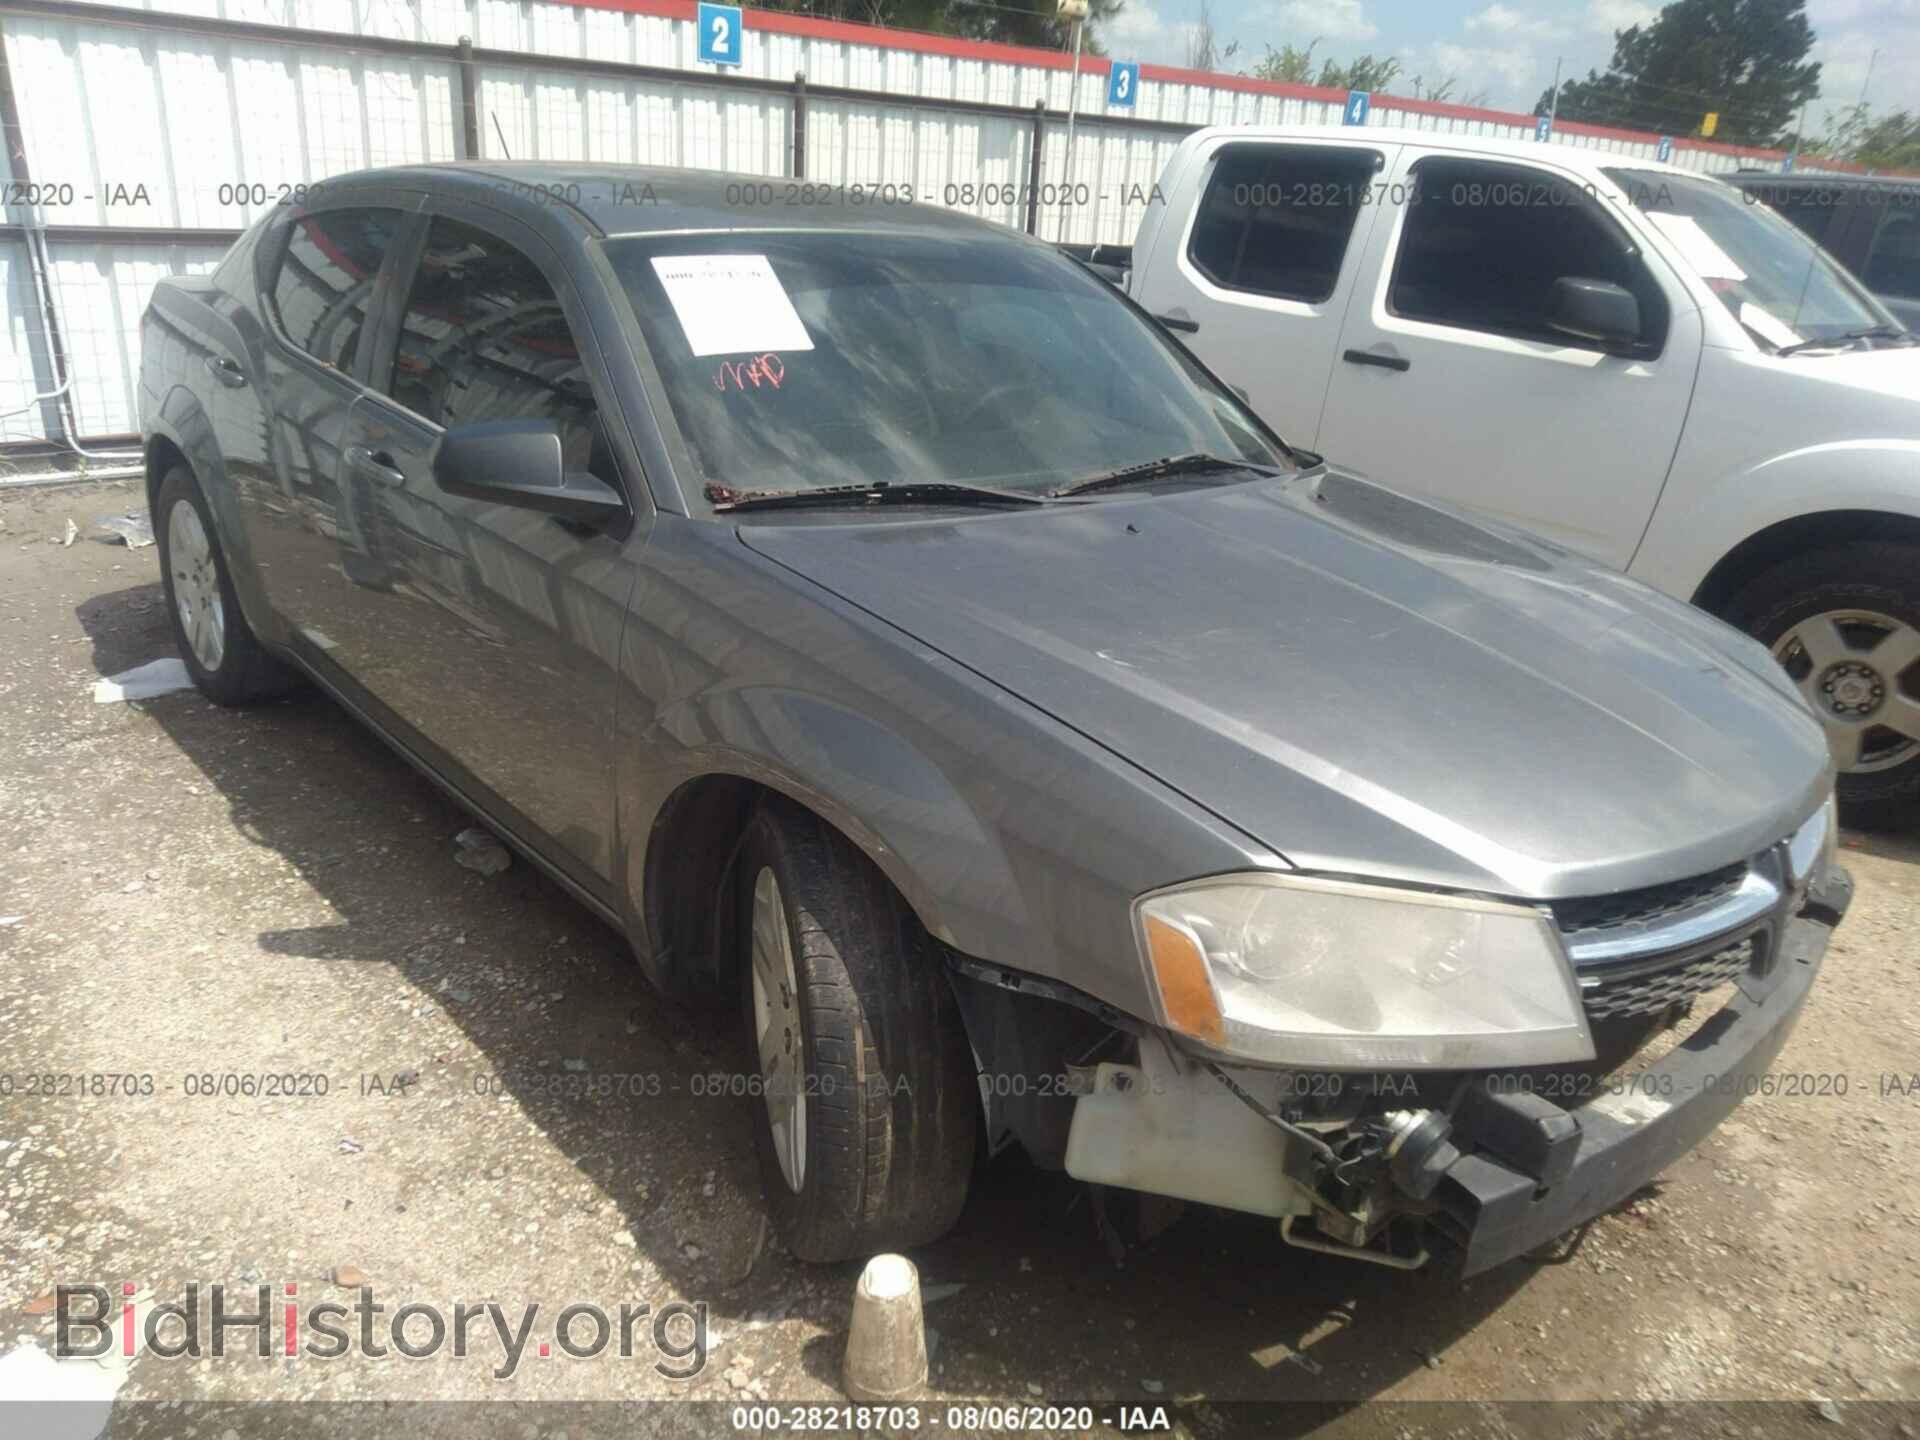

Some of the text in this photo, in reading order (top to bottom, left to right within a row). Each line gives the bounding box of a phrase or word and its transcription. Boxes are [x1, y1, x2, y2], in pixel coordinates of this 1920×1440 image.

[711, 16, 729, 54] 2
[1117, 69, 1130, 99] 3
[1351, 98, 1363, 123] 4
